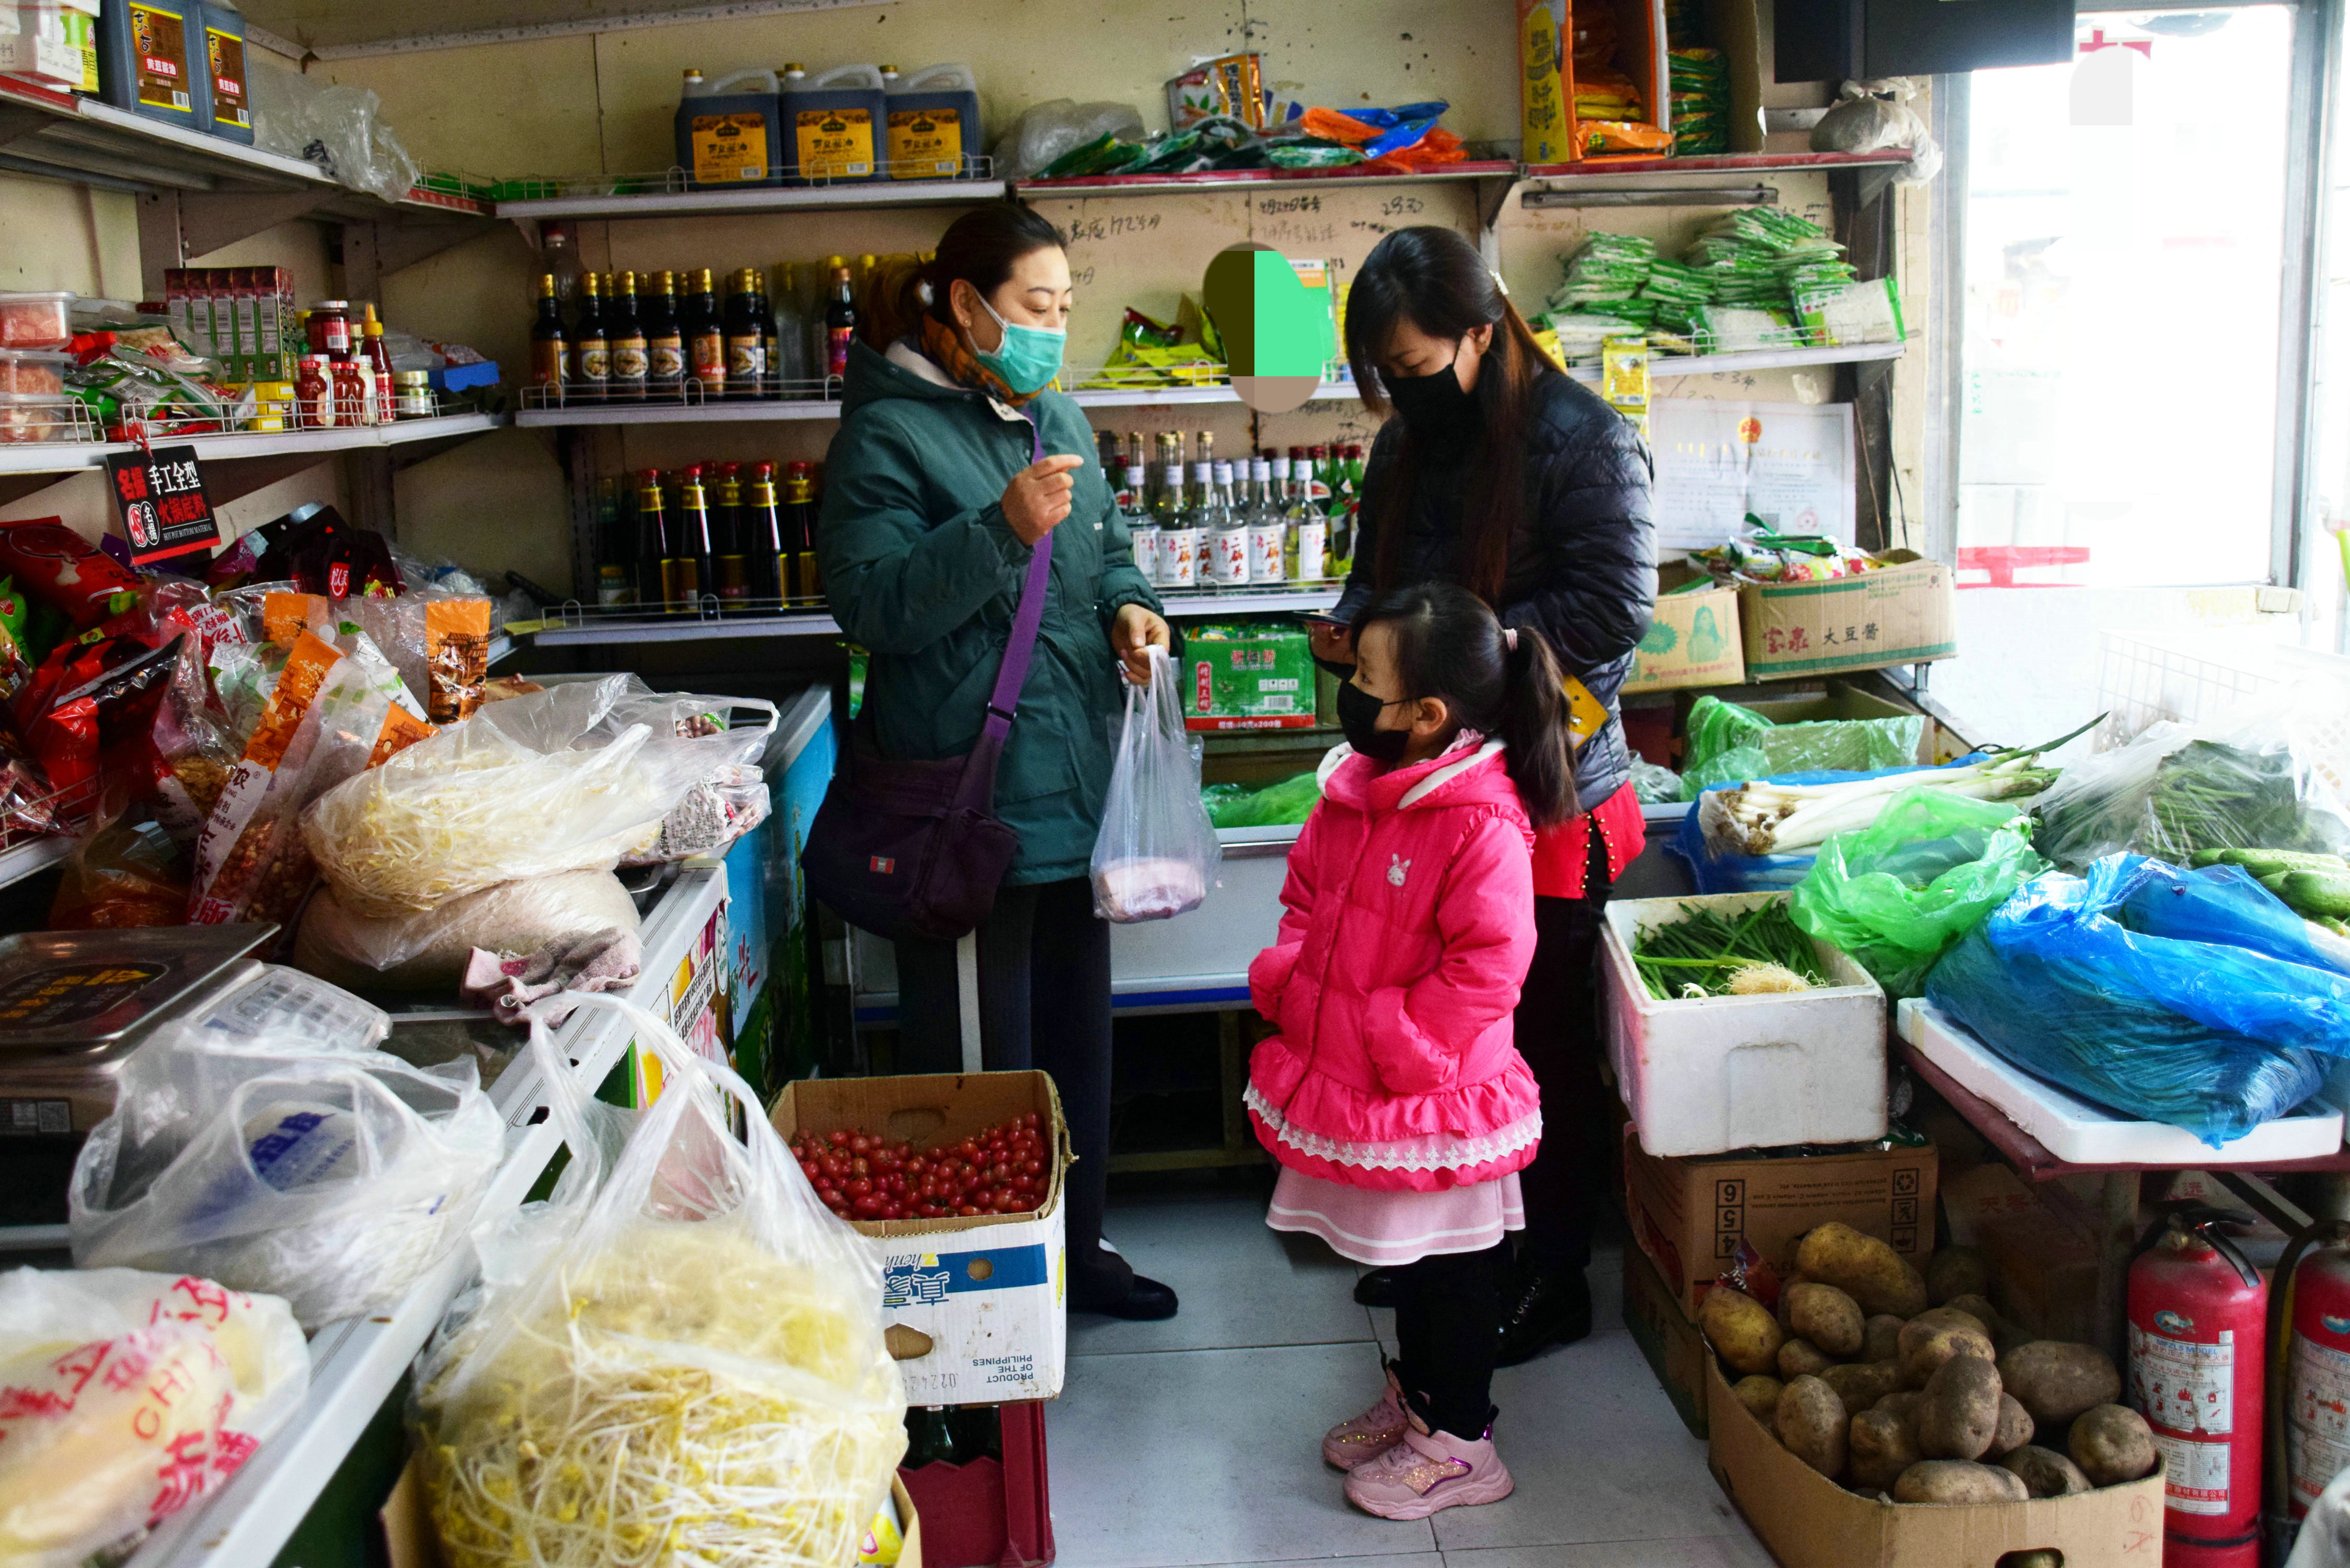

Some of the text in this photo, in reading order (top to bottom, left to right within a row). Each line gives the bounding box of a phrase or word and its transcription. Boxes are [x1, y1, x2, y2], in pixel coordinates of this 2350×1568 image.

[148, 460, 201, 495] 手工全型
[157, 492, 208, 527] 火锅底料
[163, 533, 171, 541] HOT
[179, 528, 194, 538] BOTTOM
[194, 525, 213, 536] MATERIAL
[1723, 1209, 1736, 1228] 5
[1722, 1235, 1735, 1253] 4
[973, 1354, 1033, 1366] PHILIPPINES
[998, 1364, 1033, 1374] OF THE
[986, 1373, 1034, 1383] PRODUCT
